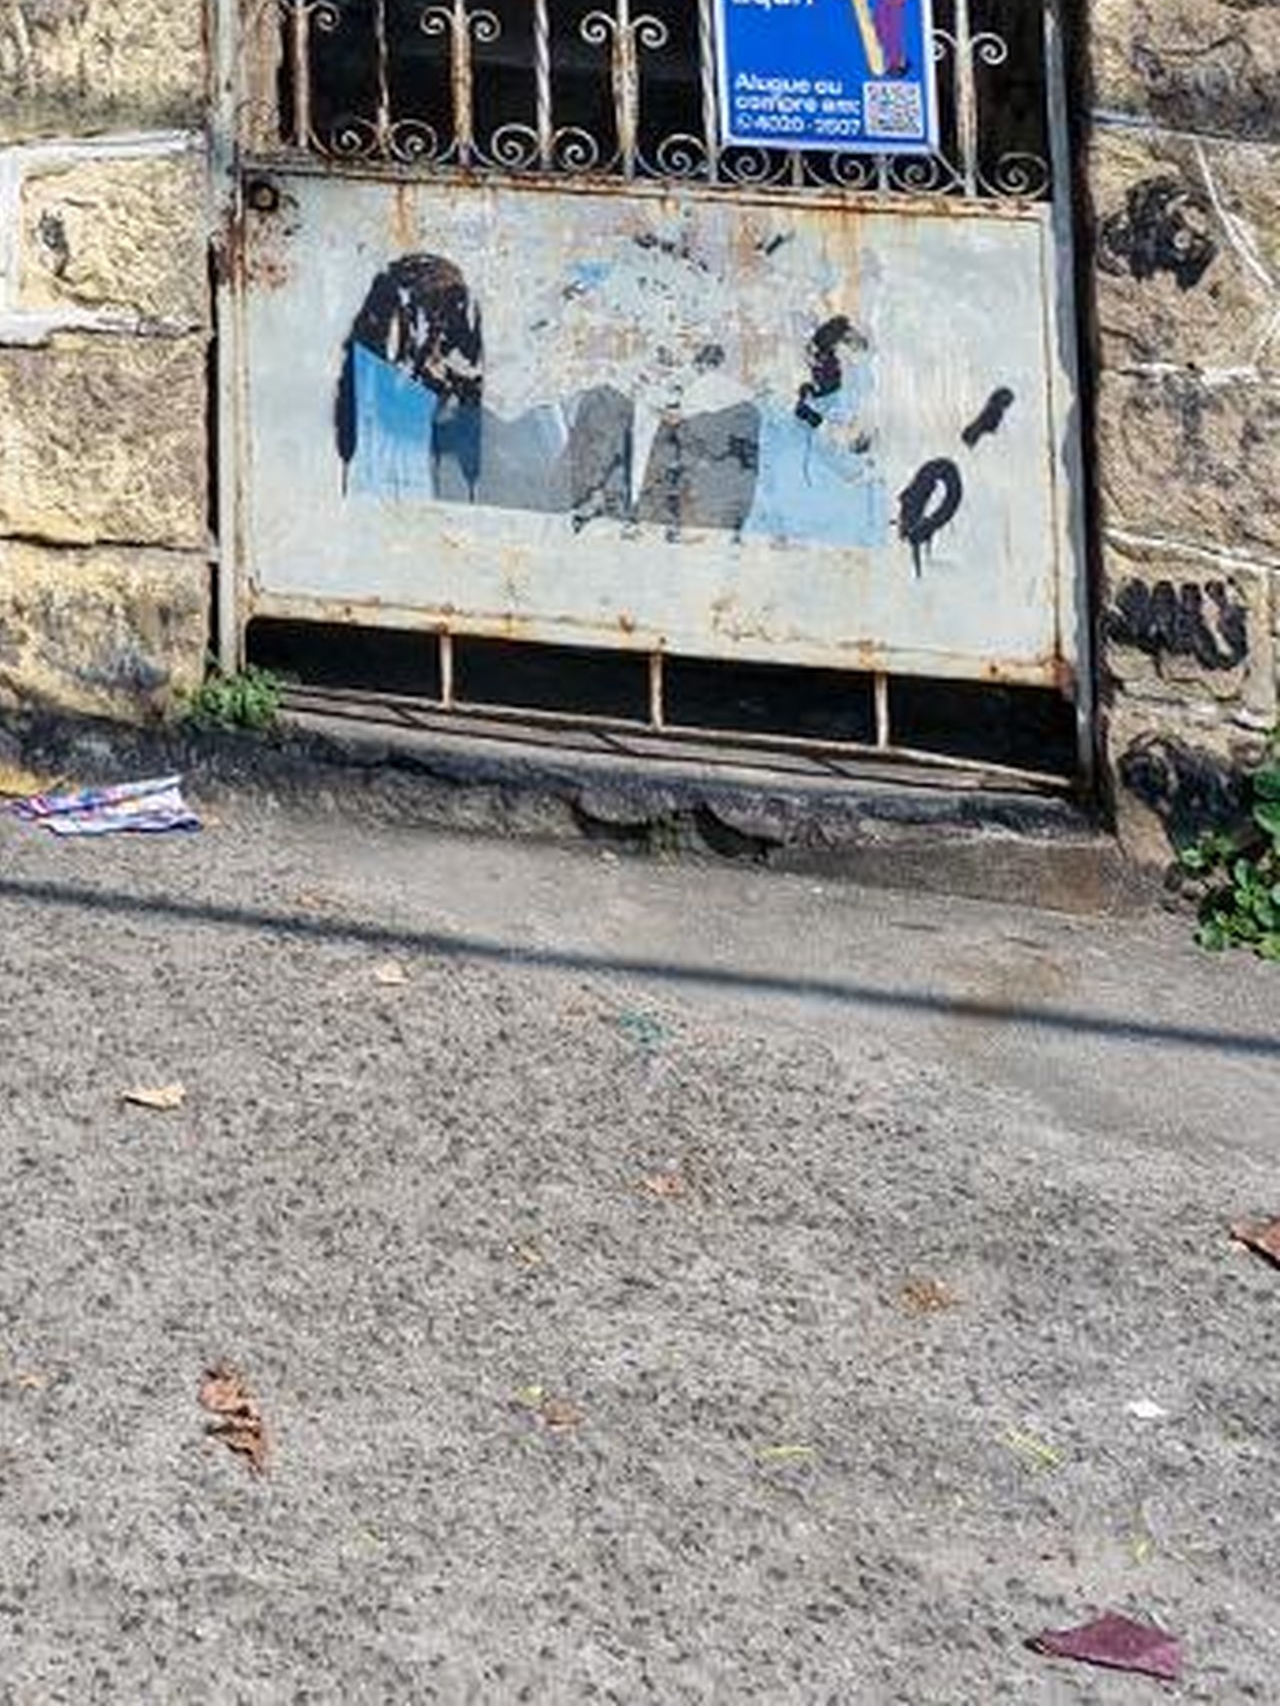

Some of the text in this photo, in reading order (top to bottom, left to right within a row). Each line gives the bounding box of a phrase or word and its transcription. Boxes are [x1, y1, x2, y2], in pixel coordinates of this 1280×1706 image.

[735, 72, 843, 98] Alugue ou
[735, 96, 818, 116] compre
